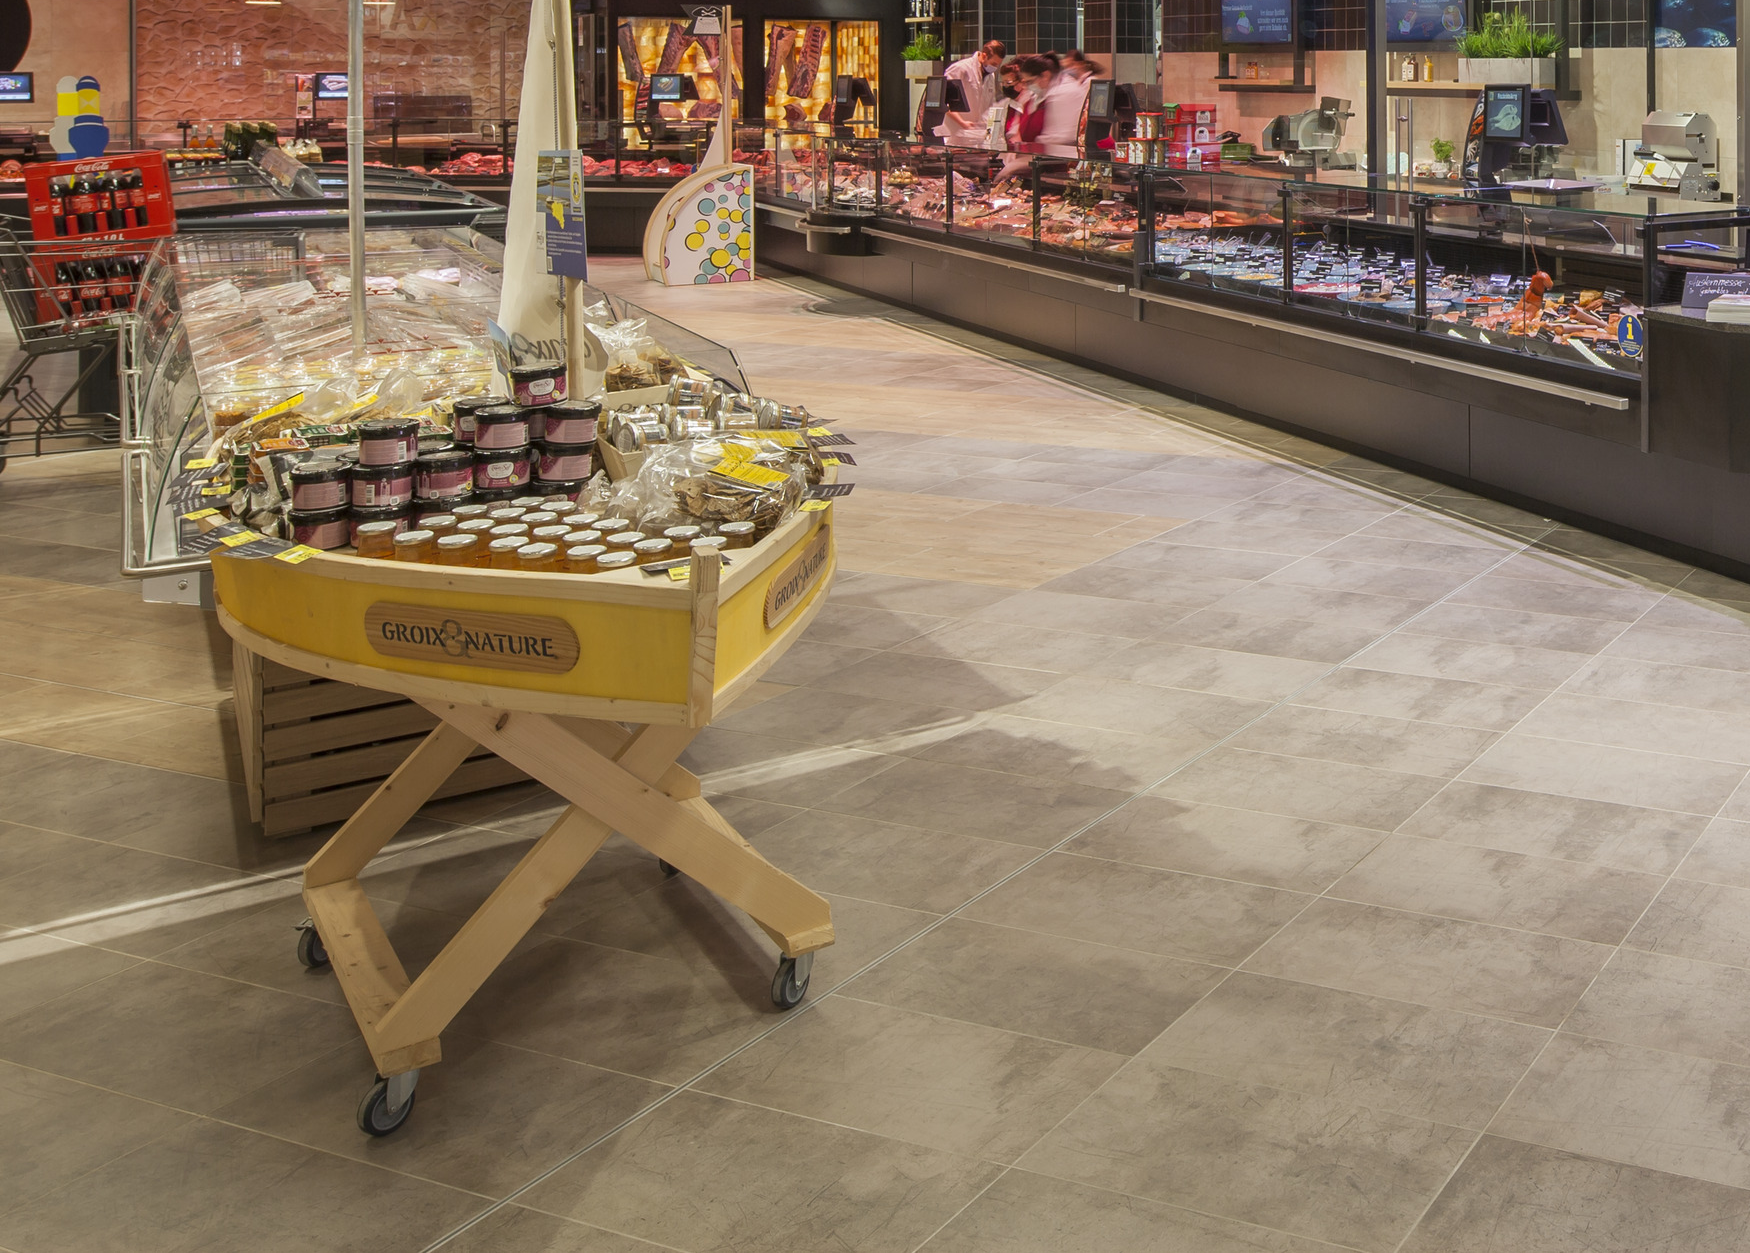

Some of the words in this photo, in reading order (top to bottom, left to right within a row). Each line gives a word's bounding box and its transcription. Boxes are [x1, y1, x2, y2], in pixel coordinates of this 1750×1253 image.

[74, 160, 111, 174] Coca-Cola
[774, 573, 800, 611] GROIX
[381, 621, 446, 647] GROIX
[442, 619, 472, 659] &
[463, 630, 558, 658] NATURE
